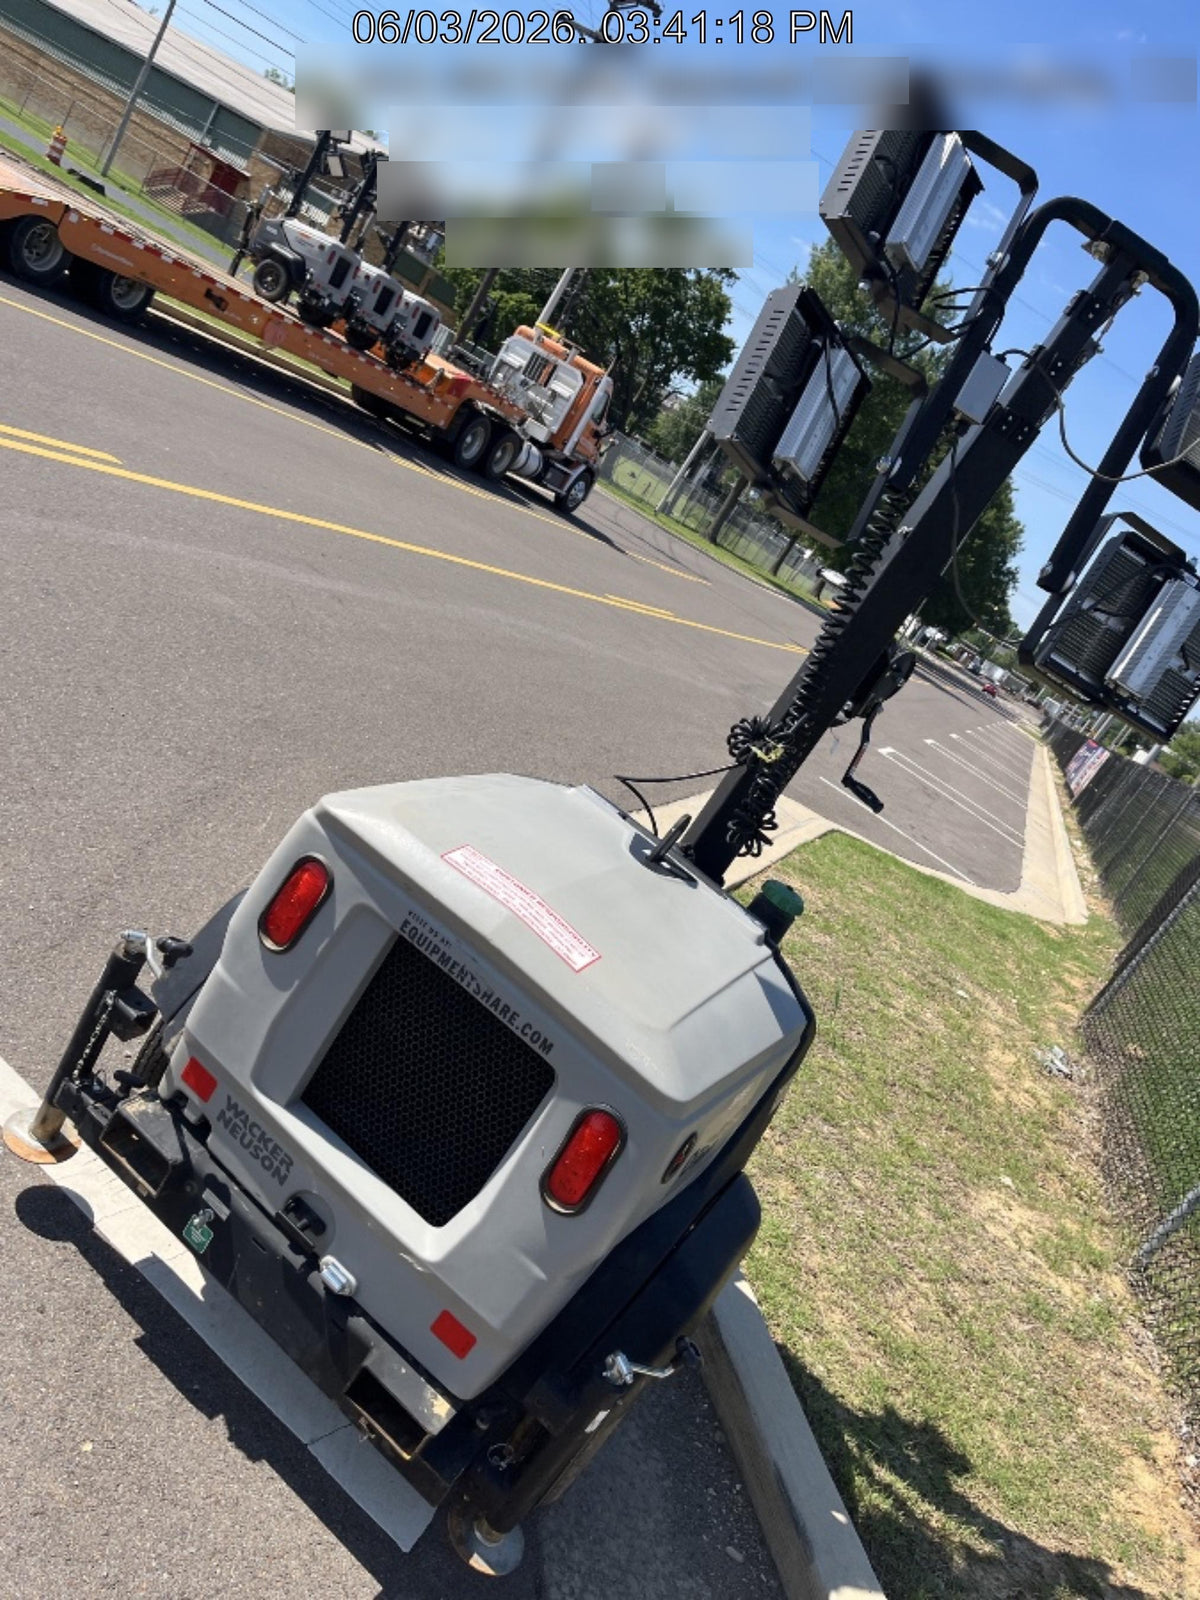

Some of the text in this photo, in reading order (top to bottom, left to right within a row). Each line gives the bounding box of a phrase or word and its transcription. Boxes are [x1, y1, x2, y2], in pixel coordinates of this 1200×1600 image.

[399, 919, 554, 1056] EQUIPMENTSHARE.COM
[216, 1108, 289, 1187] NEUSON
[226, 1094, 294, 1174] WACKER
